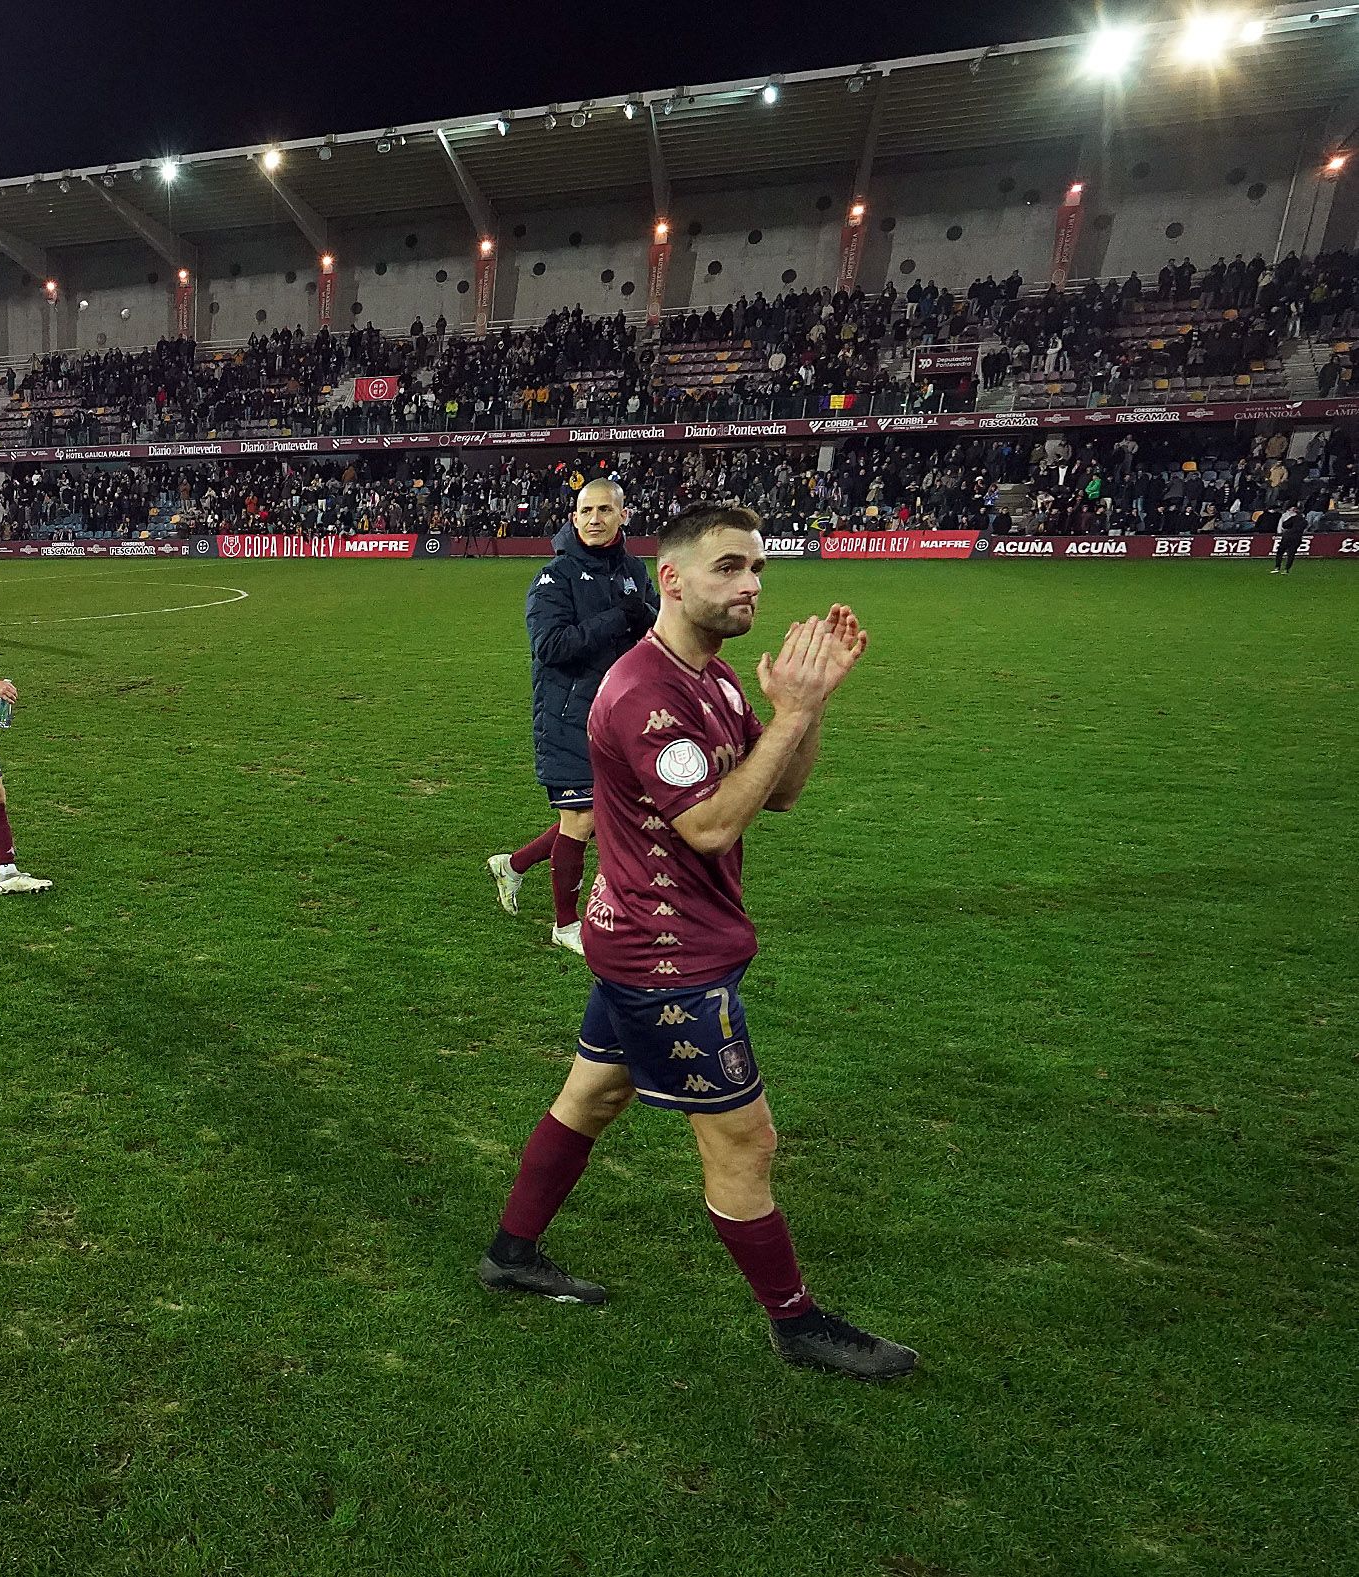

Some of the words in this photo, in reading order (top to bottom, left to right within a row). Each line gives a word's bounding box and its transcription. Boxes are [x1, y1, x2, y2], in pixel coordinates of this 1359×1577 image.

[1116, 412, 1179, 422] PESCAMAR
[1234, 411, 1302, 420] CAMPANIOLA
[979, 418, 1038, 427] PESCAMAR
[570, 430, 599, 441] Diario
[609, 427, 665, 439] Pontevedra
[684, 427, 716, 437] Diario
[728, 424, 786, 436] Pontevedra
[148, 445, 171, 456] Diario
[179, 444, 222, 454] Pontevedra
[240, 442, 264, 452] Diario
[273, 440, 318, 451] Pontevedra
[244, 536, 277, 557] COPA
[283, 536, 304, 557] DEL
[311, 536, 336, 557] REY
[345, 540, 409, 551] MAPFRE
[765, 538, 806, 550] FROIZ
[841, 537, 867, 551] COPA
[868, 537, 887, 551] DEL
[890, 537, 909, 551] REY
[920, 540, 970, 549] MAPFRE
[993, 539, 1053, 553] ACUÑA
[1065, 539, 1127, 553] ACUÑA
[41, 547, 85, 555] PESCAMAR
[110, 546, 156, 555] PESCAMAR
[705, 988, 732, 1039] 7
